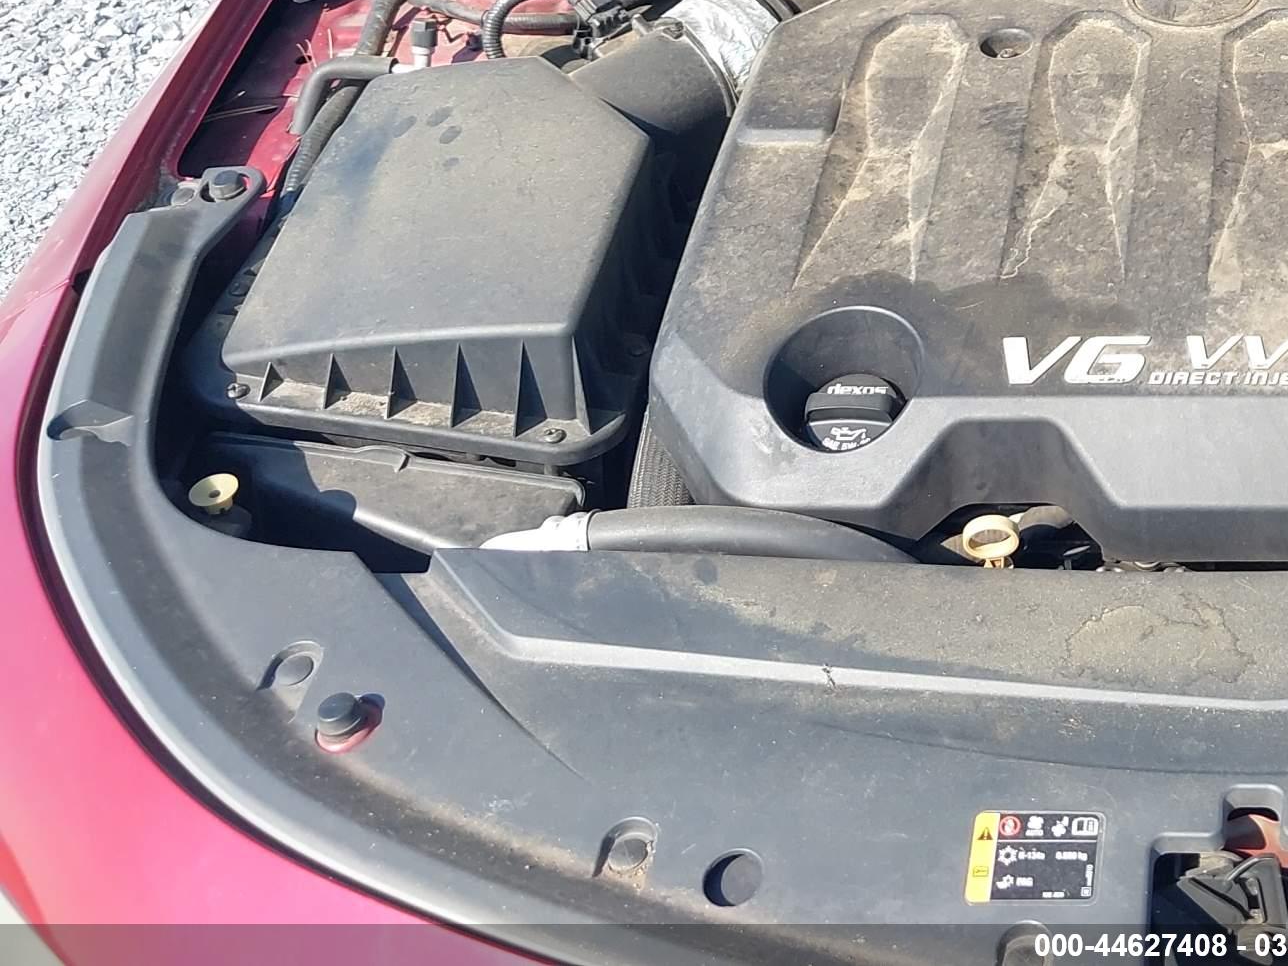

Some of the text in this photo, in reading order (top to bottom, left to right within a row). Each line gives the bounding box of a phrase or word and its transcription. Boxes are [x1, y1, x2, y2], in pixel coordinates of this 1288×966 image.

[1002, 335, 1152, 385] V6
[1149, 370, 1240, 385] DIRECT
[826, 382, 889, 395] dexos
